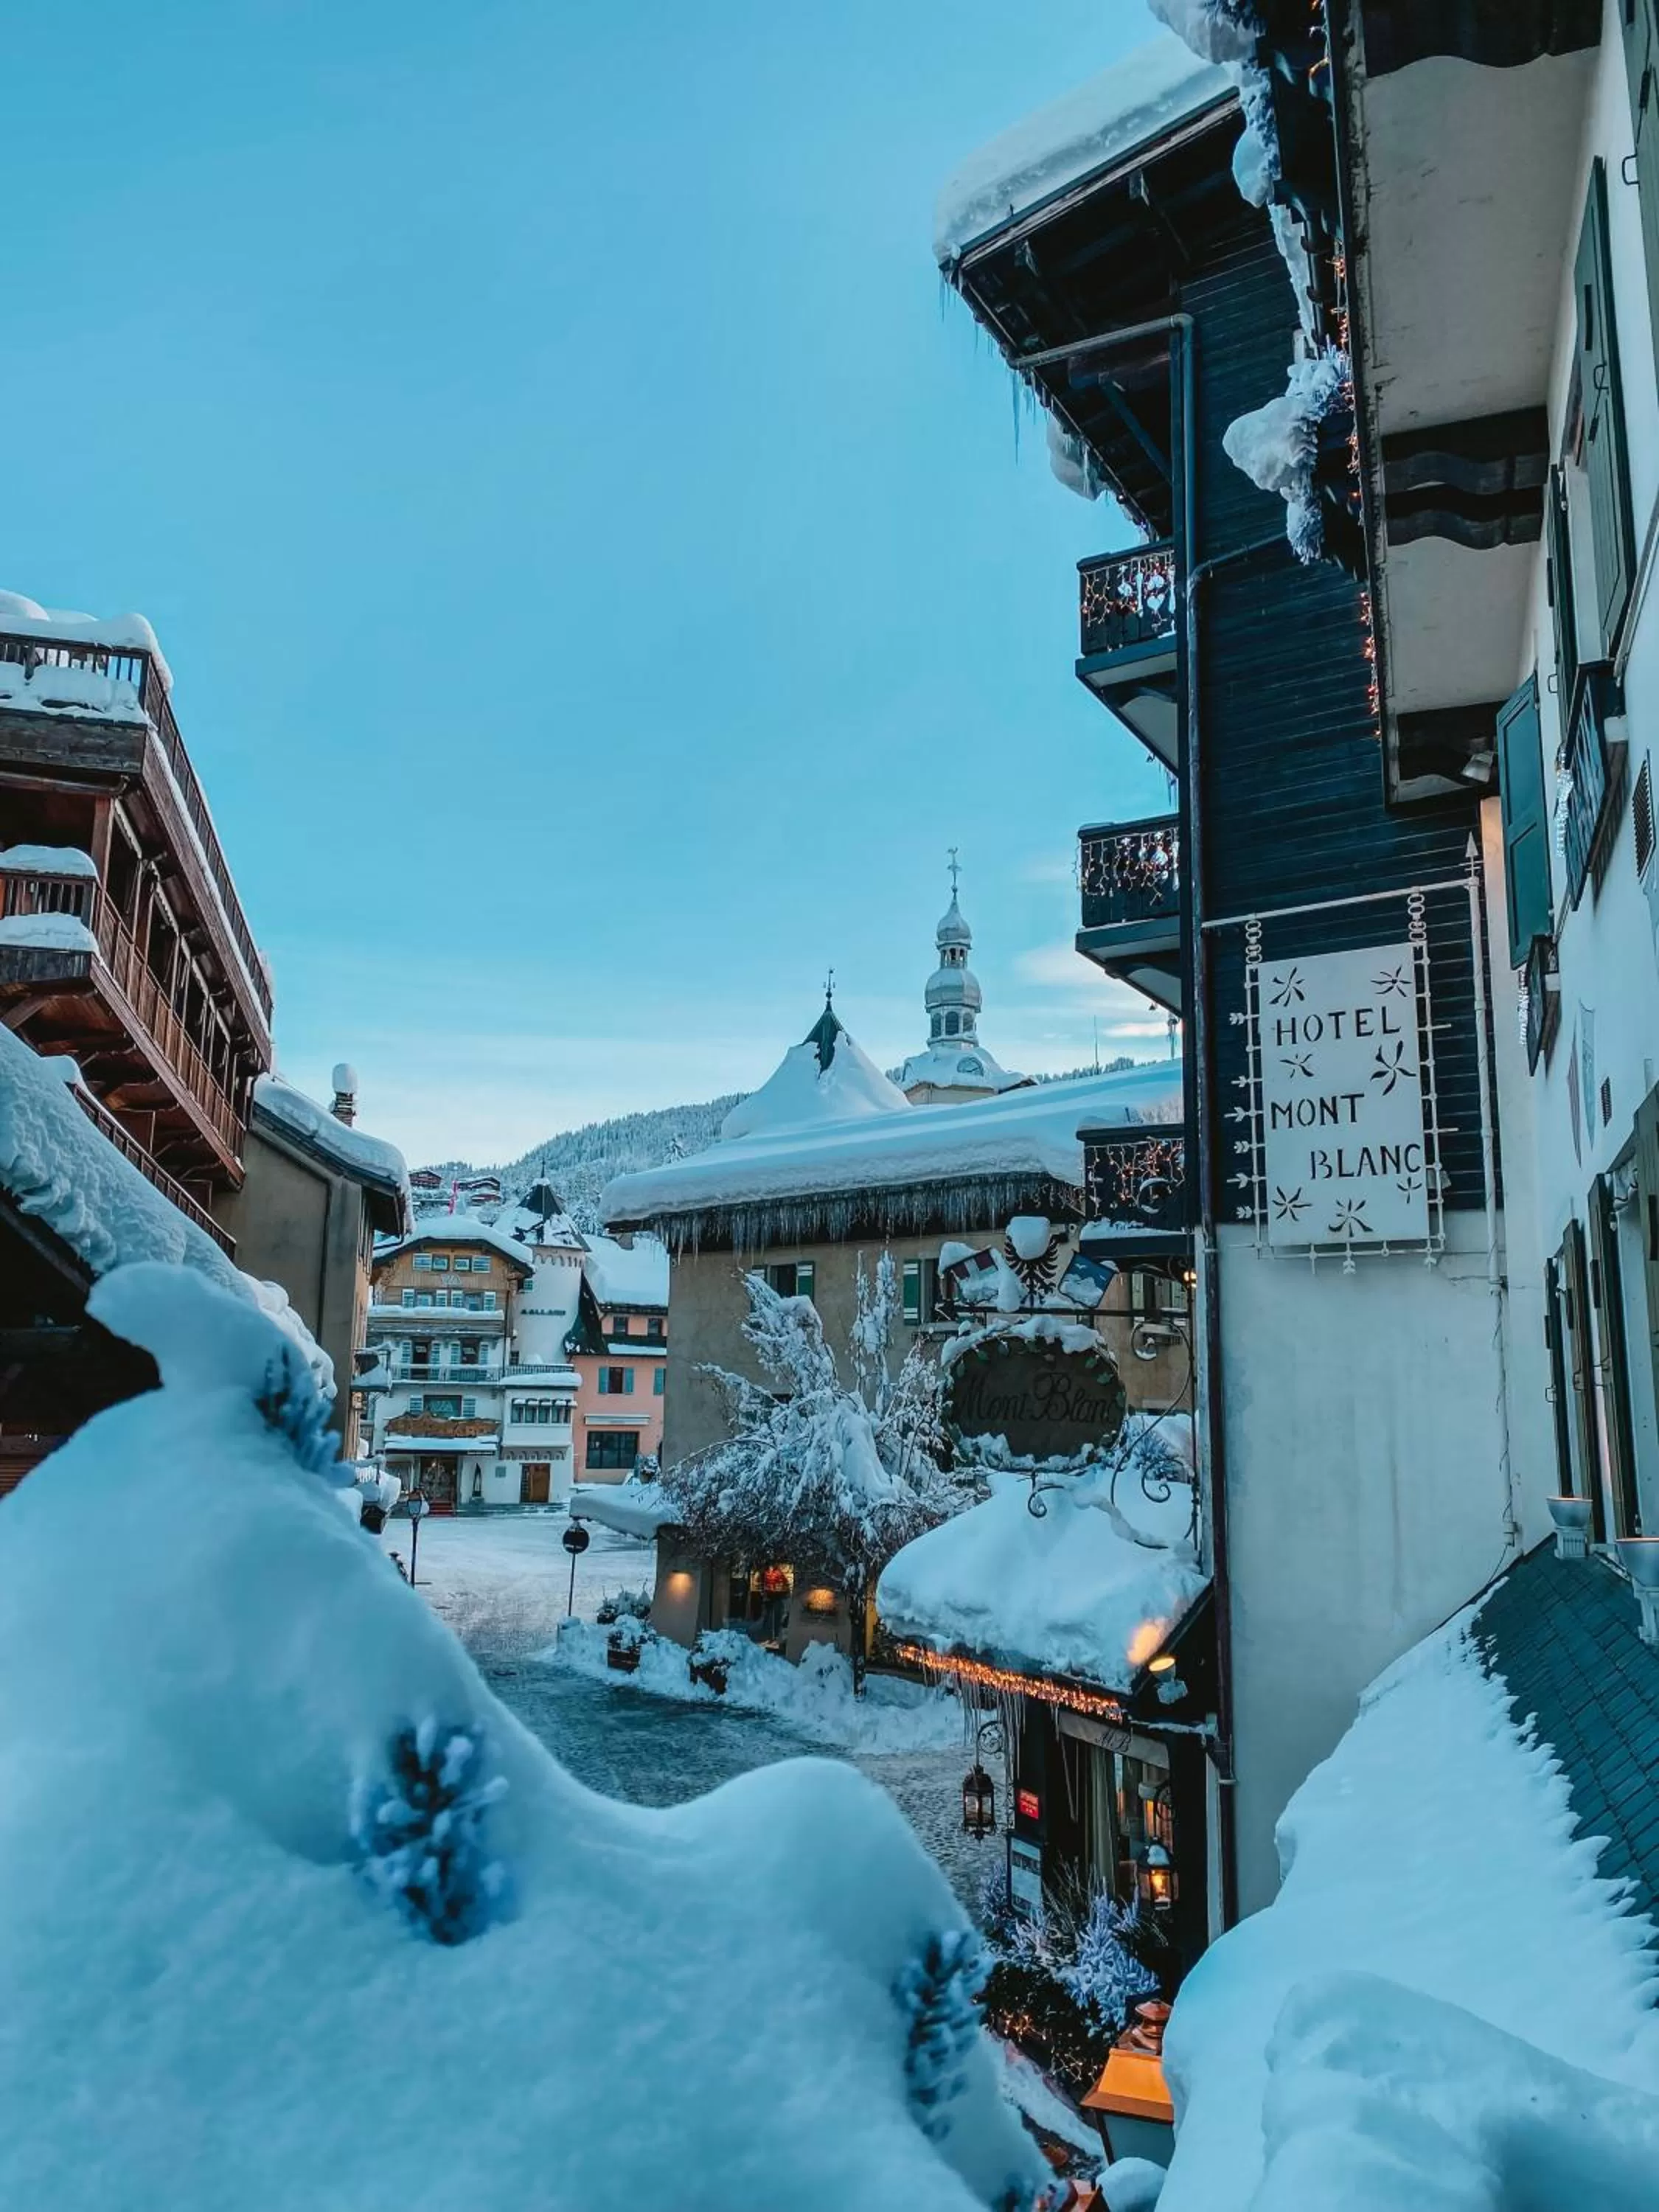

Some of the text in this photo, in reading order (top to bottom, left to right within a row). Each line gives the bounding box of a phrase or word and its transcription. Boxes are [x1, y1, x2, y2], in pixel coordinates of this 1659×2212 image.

[1275, 1006, 1402, 1046] HOTEL
[1270, 1093, 1365, 1130] MONT
[1310, 1144, 1422, 1180] BLANC
